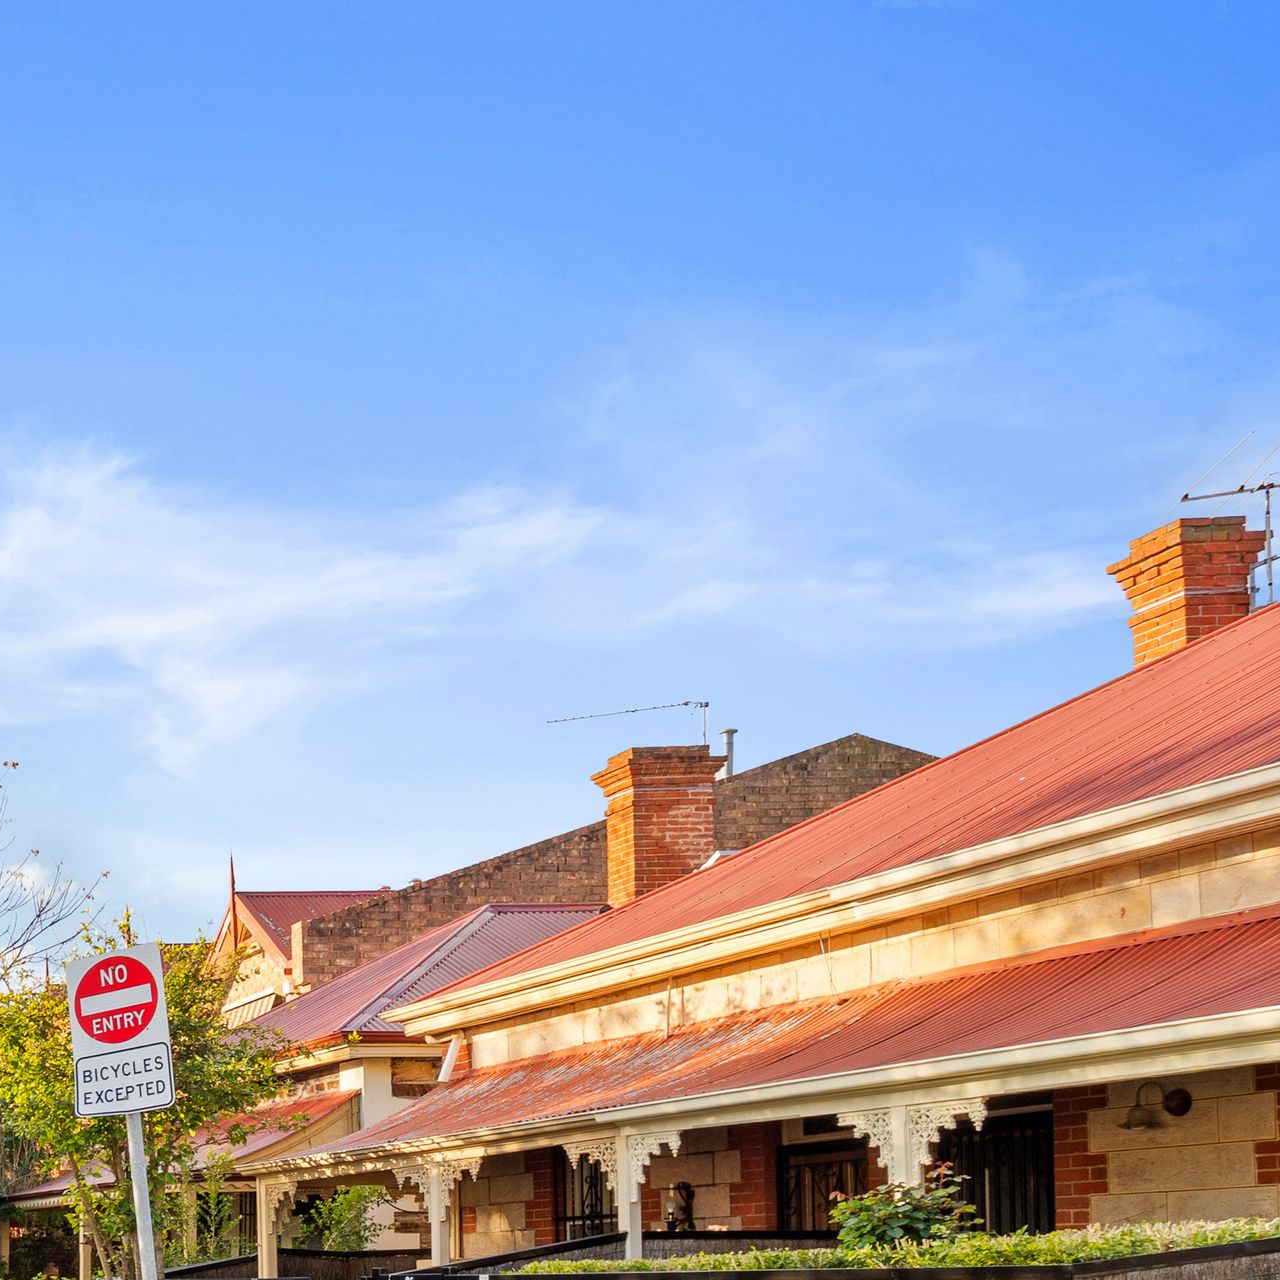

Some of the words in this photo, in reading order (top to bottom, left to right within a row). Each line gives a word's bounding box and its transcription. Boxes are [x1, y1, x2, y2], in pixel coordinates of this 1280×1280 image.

[100, 964, 128, 988] NO
[92, 1009, 146, 1036] ENTRY
[83, 1056, 164, 1084] BICYCLES
[83, 1079, 166, 1106] EXCEPTED
